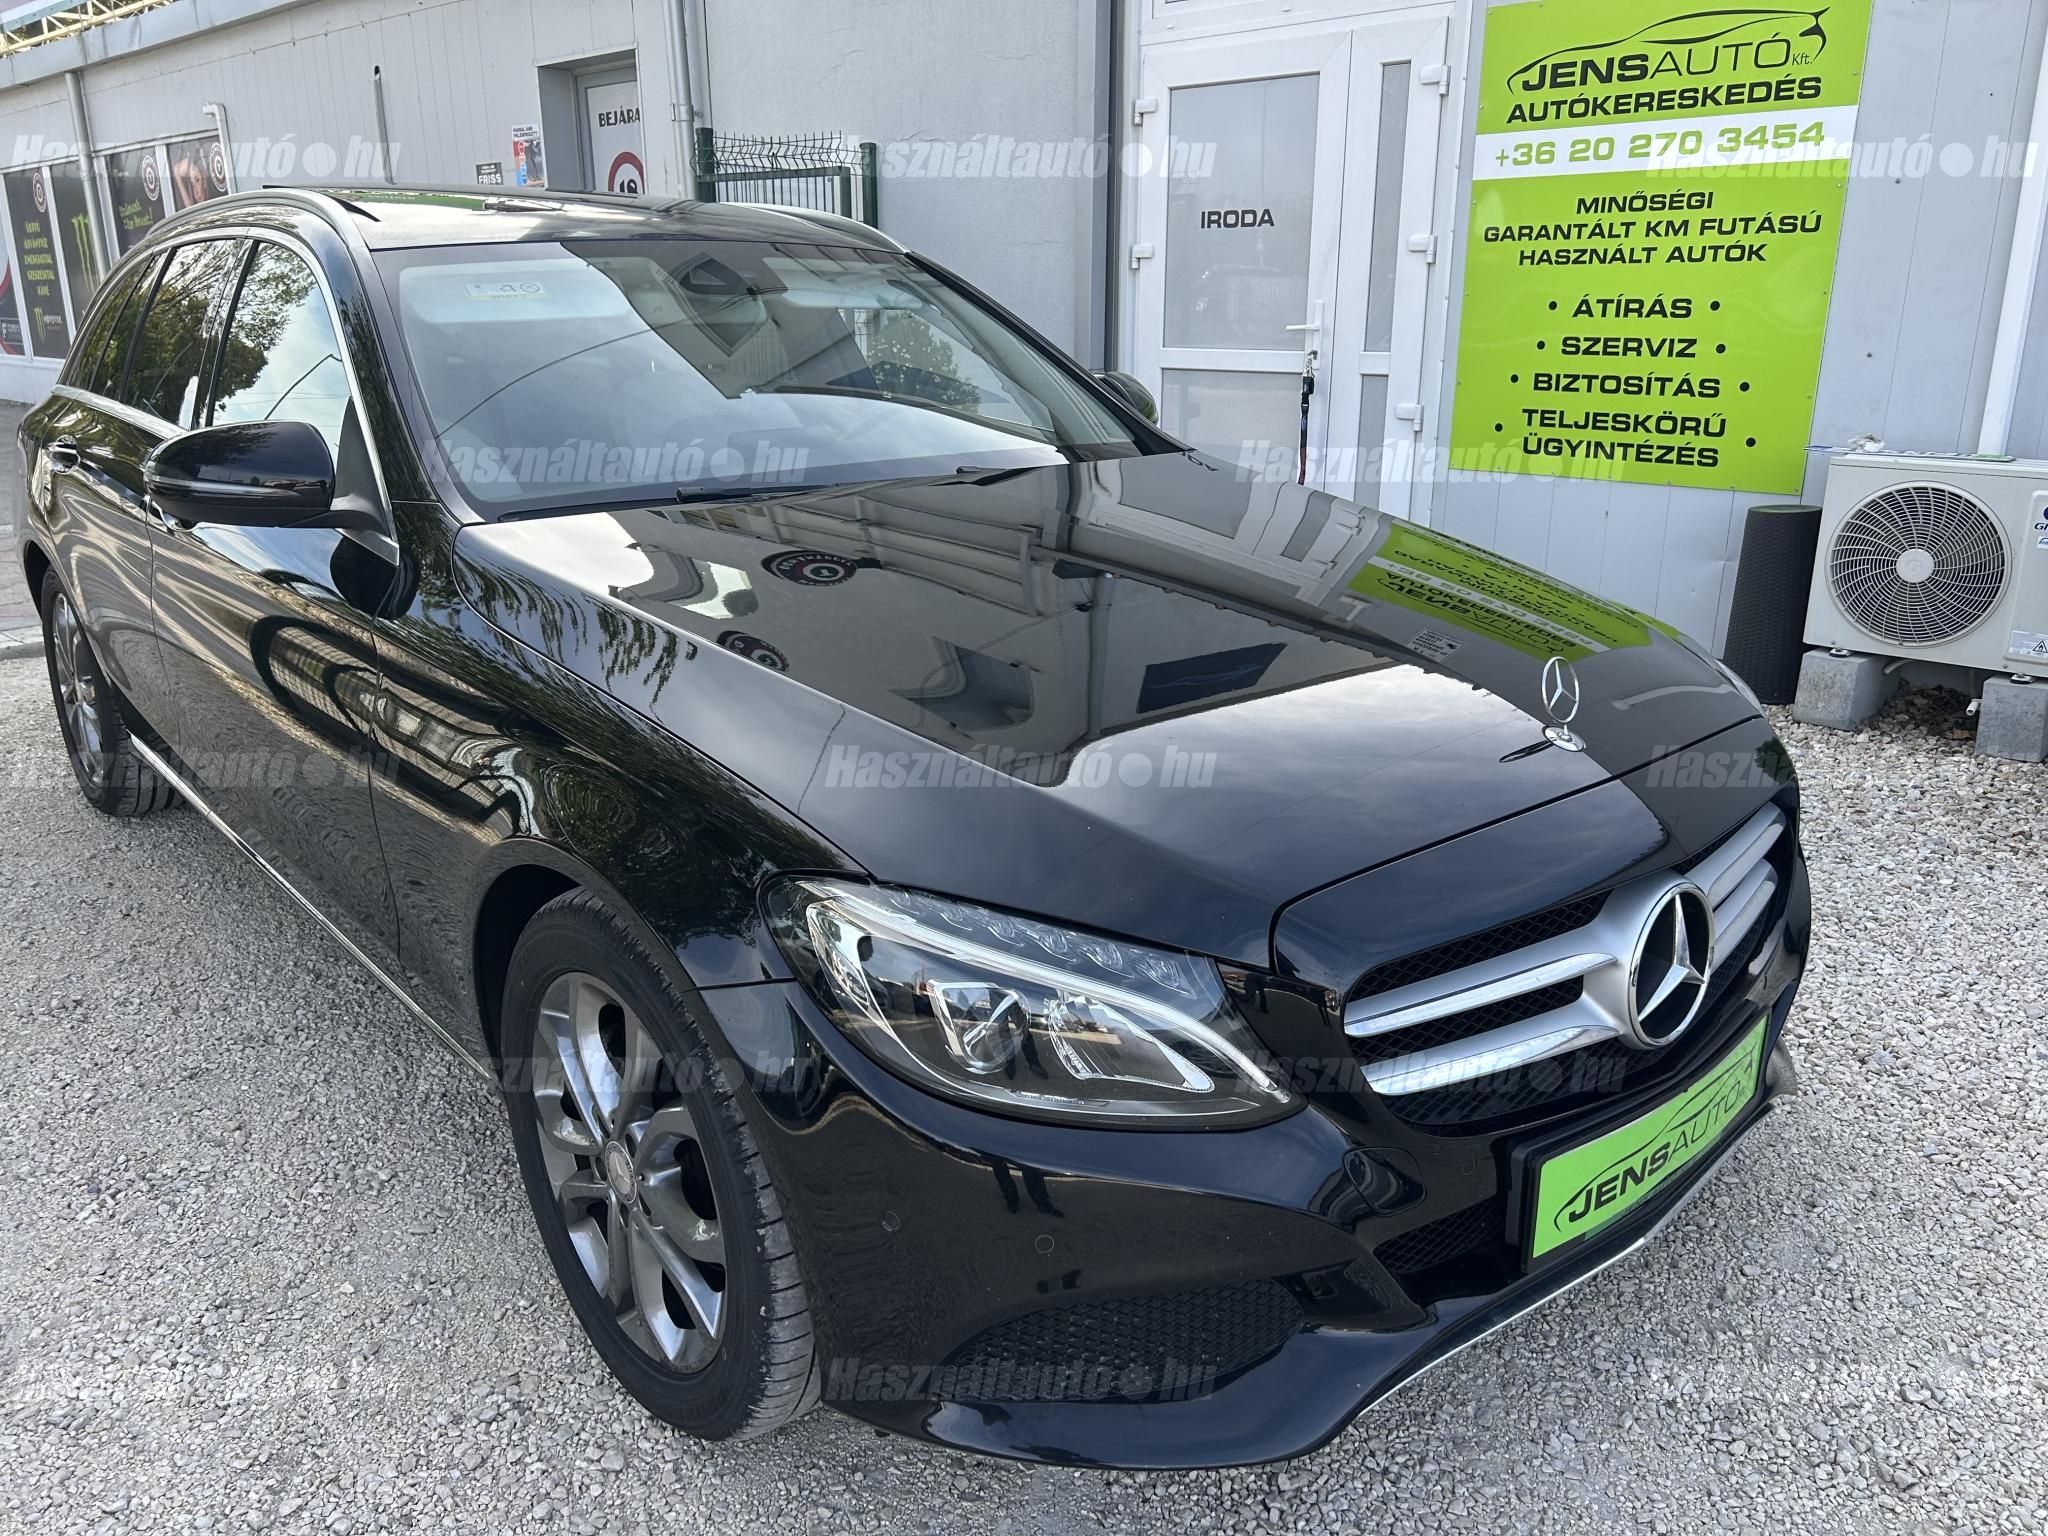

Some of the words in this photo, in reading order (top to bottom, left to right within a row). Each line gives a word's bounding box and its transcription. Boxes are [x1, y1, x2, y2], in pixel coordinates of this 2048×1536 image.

[1522, 33, 1791, 91] JENSAUTÓ
[1792, 51, 1813, 67] Kft.
[1506, 73, 1822, 124] AUTÓKERESKEDÉS
[1496, 141, 1556, 167] +36
[1569, 136, 1615, 162] 20
[1628, 130, 1703, 158] 270
[1717, 121, 1825, 154] 3454
[479, 173, 501, 185] FRISS
[1576, 191, 1714, 214] MINŐSÉGI
[1200, 208, 1275, 229] IRODA
[1484, 217, 1636, 243] GARANTÁLT
[1645, 220, 1689, 238] KM
[1699, 209, 1822, 237] FUTÁSÚ
[1519, 245, 1657, 266] HASZNÁLT
[1666, 240, 1767, 263] AUTÓK
[1572, 293, 1693, 319] ÁTÍRÁS
[1561, 336, 1697, 359] SZERVIZ
[1533, 371, 1721, 398] BIZTOSÍTÁS
[1522, 407, 1727, 438] TELJESKÖRŰ
[1522, 434, 1719, 467] ÜGYINTÉZÉS
